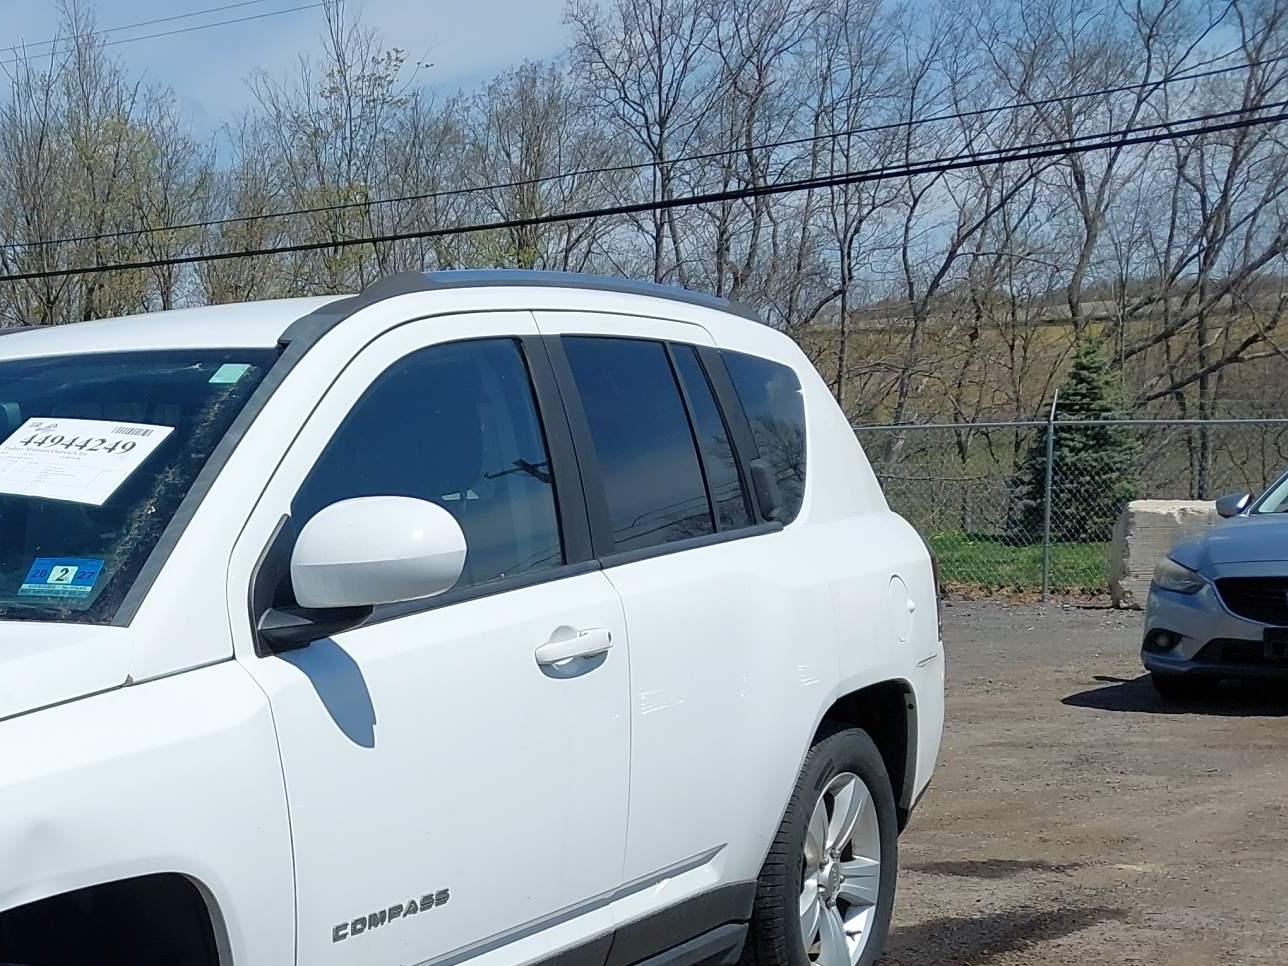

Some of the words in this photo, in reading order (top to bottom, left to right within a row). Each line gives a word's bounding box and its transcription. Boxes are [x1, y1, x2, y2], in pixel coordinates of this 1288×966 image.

[20, 433, 136, 454] 44944249
[55, 567, 70, 582] 2
[332, 888, 450, 943] COMPASS
